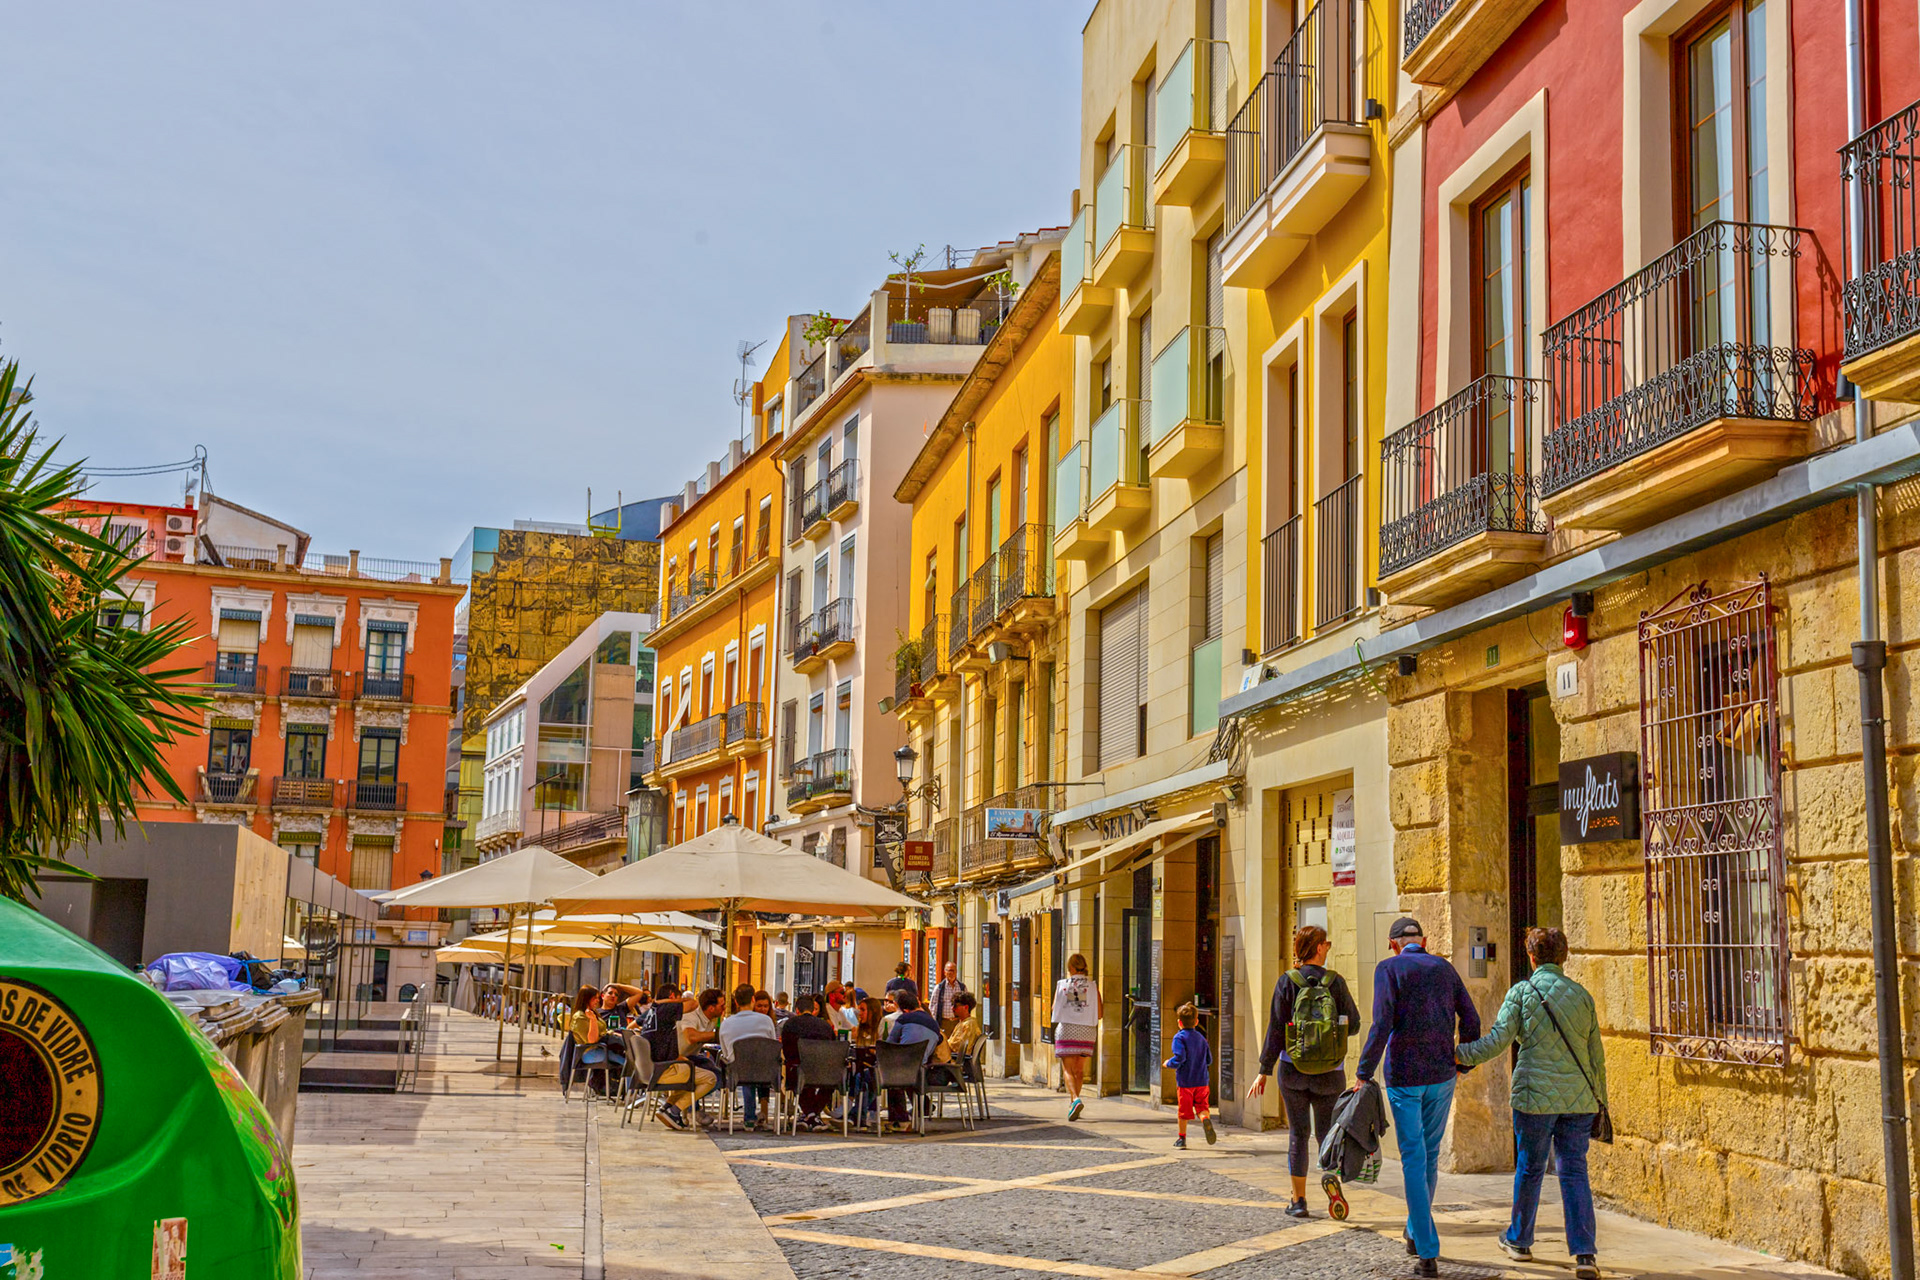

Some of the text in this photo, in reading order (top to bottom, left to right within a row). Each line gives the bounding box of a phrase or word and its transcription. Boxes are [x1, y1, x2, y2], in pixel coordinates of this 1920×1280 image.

[1562, 670, 1571, 690] 11
[1563, 764, 1620, 838] myflats
[0, 988, 95, 1084] S DE VIDRE
[1, 1112, 92, 1199] DE VIDRIO
